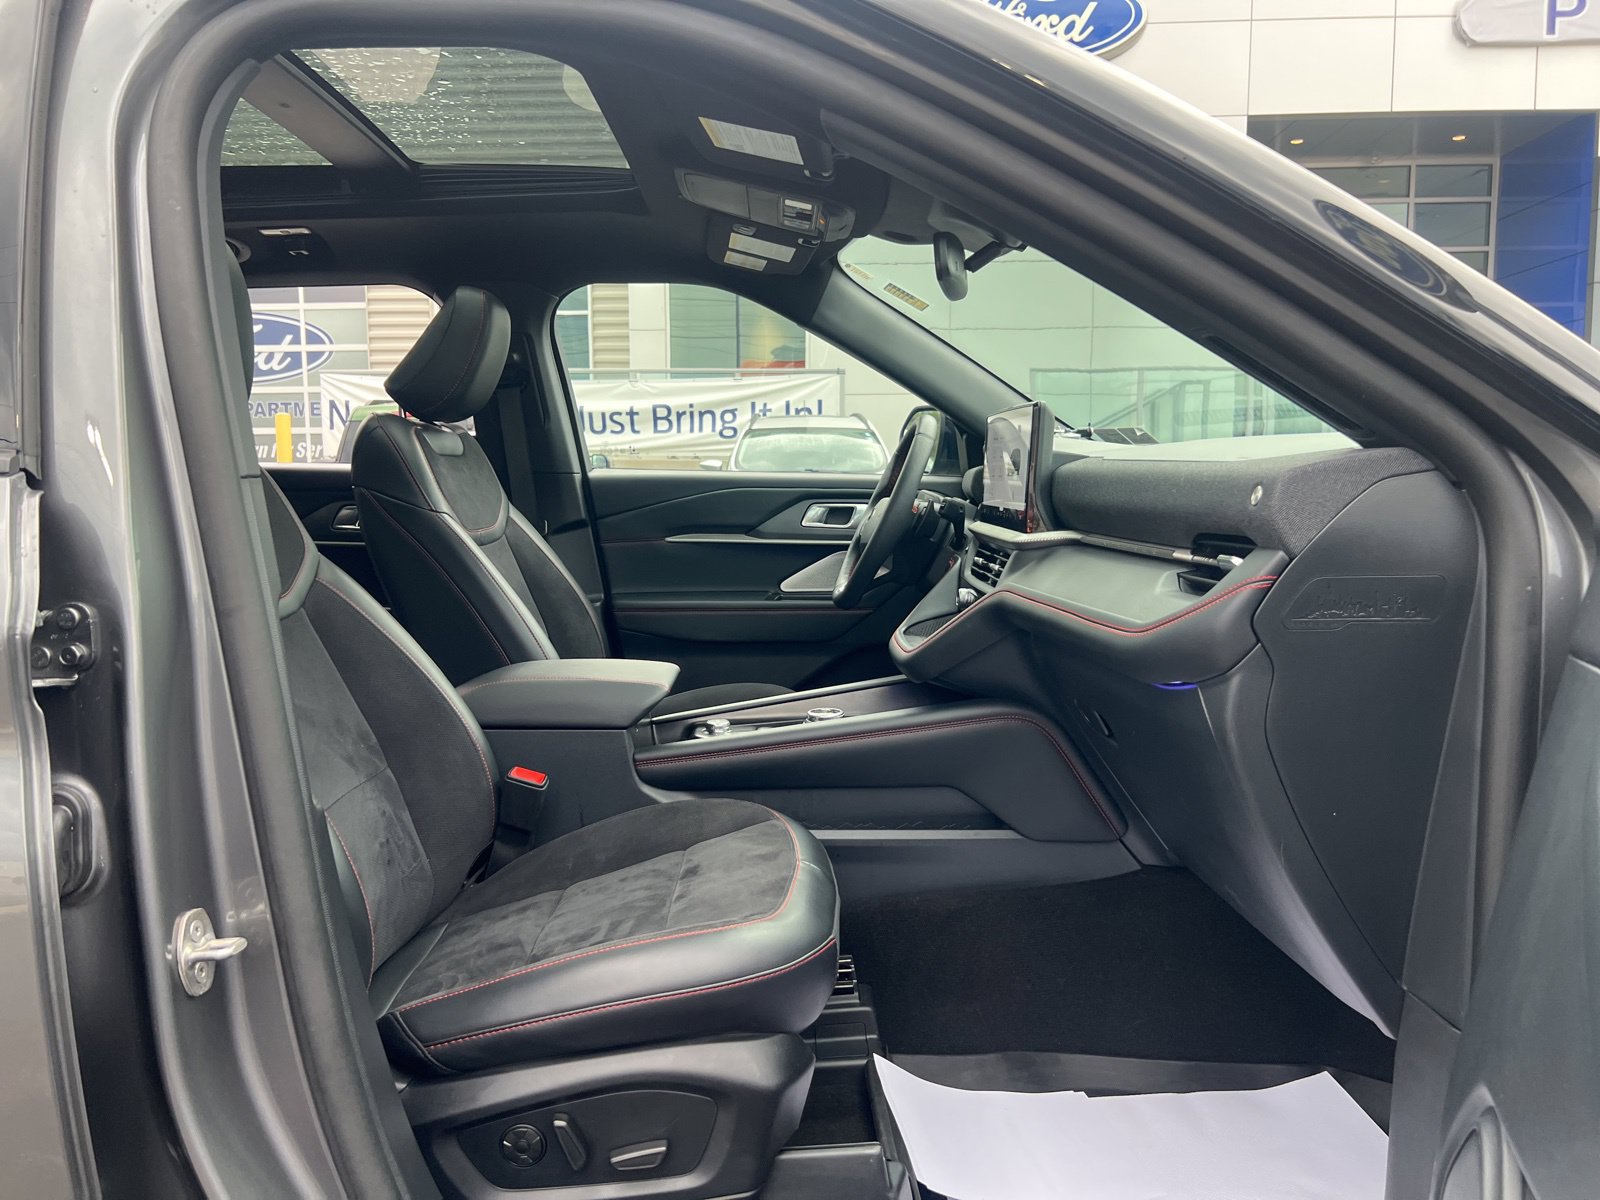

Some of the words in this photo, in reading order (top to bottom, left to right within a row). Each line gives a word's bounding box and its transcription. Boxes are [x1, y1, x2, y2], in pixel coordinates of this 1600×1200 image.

[1545, 0, 1588, 36] P
[579, 405, 641, 435] Just
[652, 403, 738, 439] Bring
